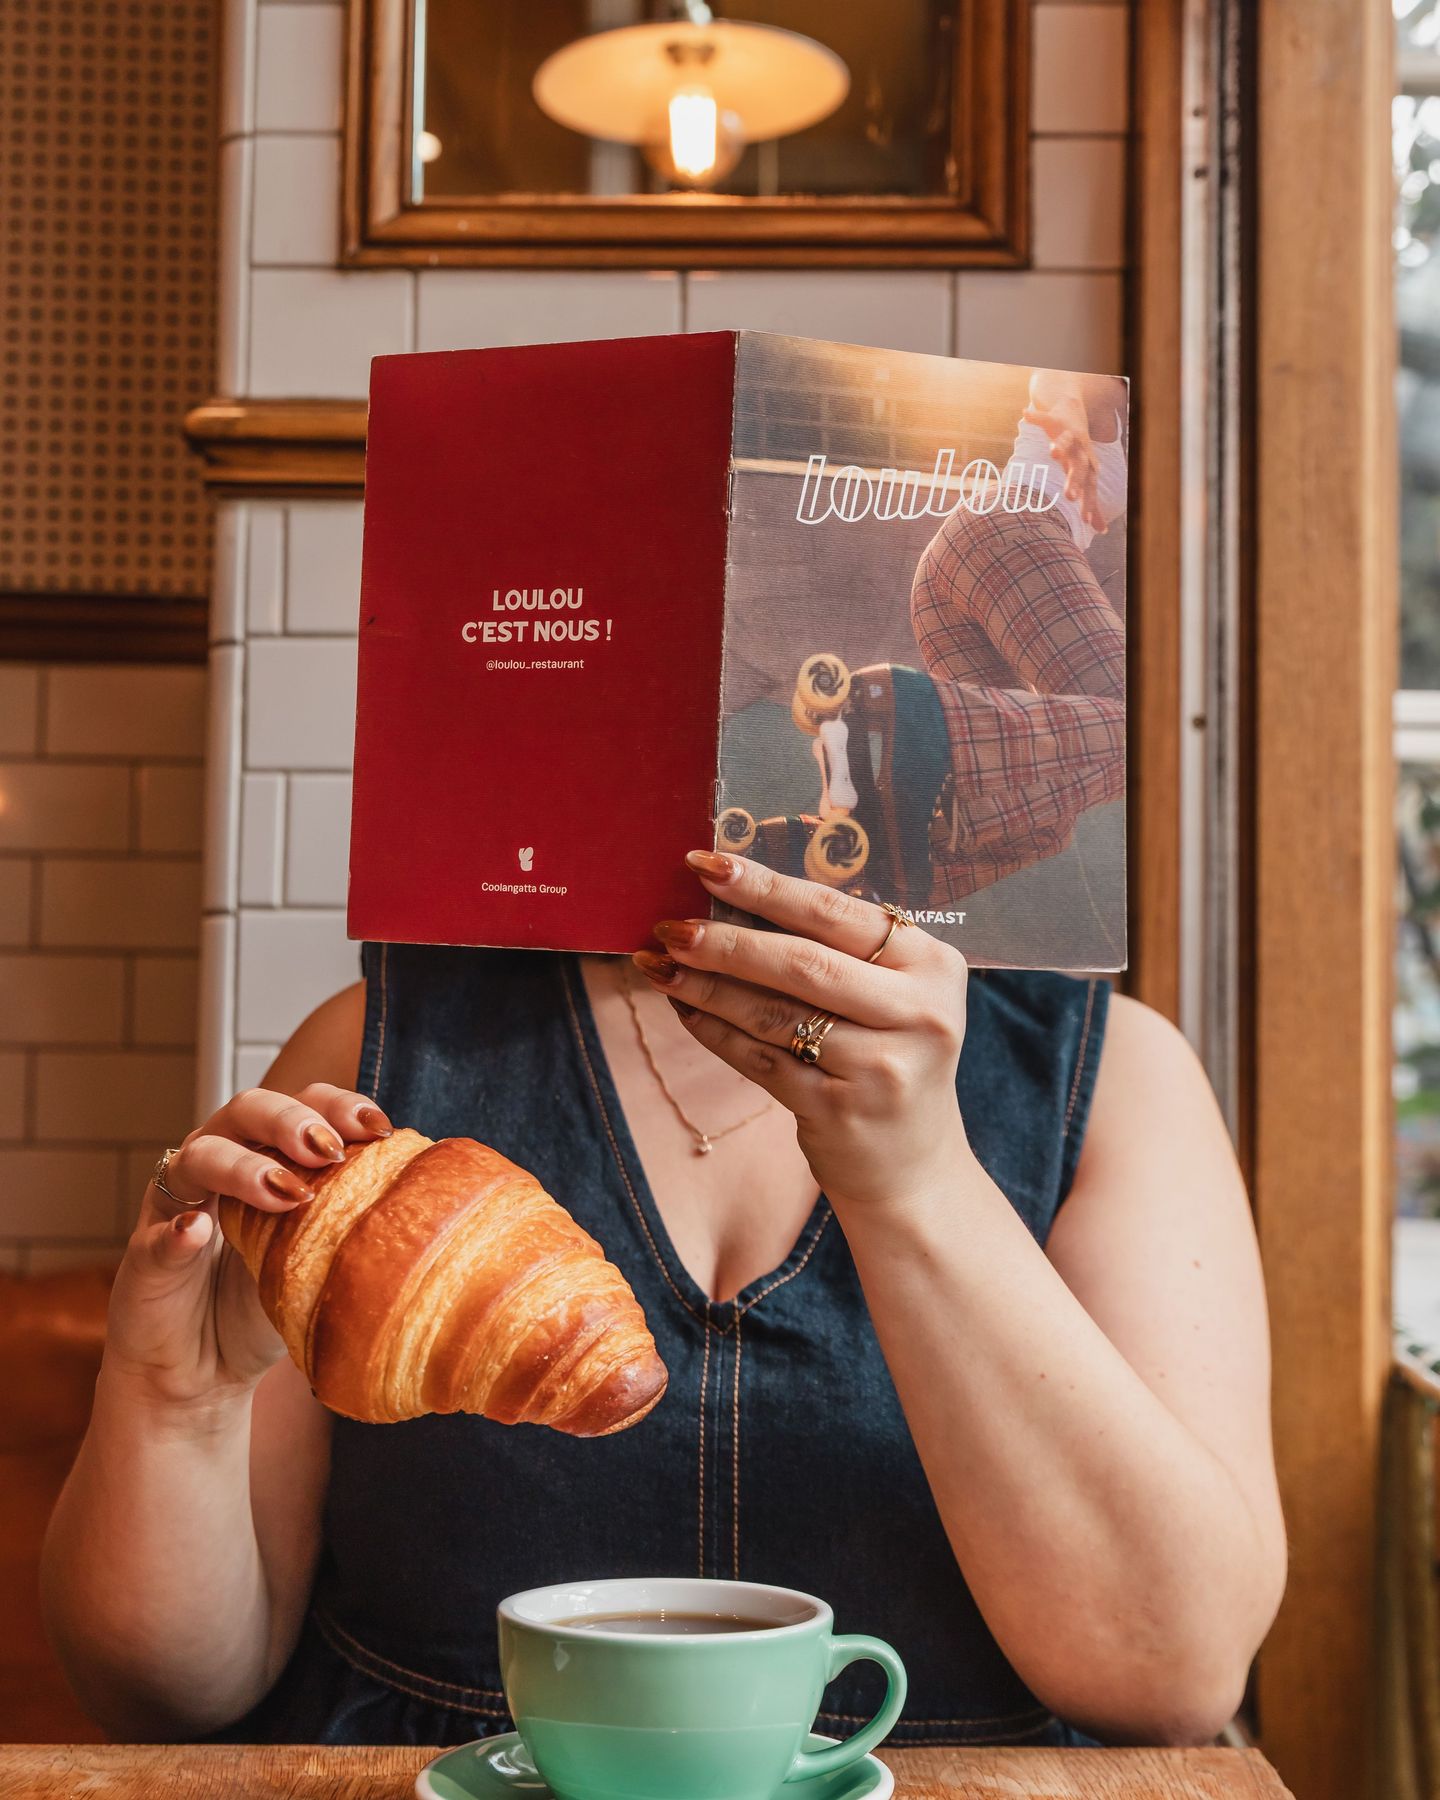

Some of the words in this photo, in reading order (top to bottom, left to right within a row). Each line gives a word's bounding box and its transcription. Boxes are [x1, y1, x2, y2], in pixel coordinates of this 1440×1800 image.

[492, 588, 584, 611] LOULOU
[461, 621, 529, 643] C'EST
[533, 620, 600, 642] NOUS
[486, 659, 585, 671] @loulou_restaurant
[481, 882, 537, 895] Coolangatta
[539, 884, 568, 896] Group
[904, 909, 967, 925] AKFAST
